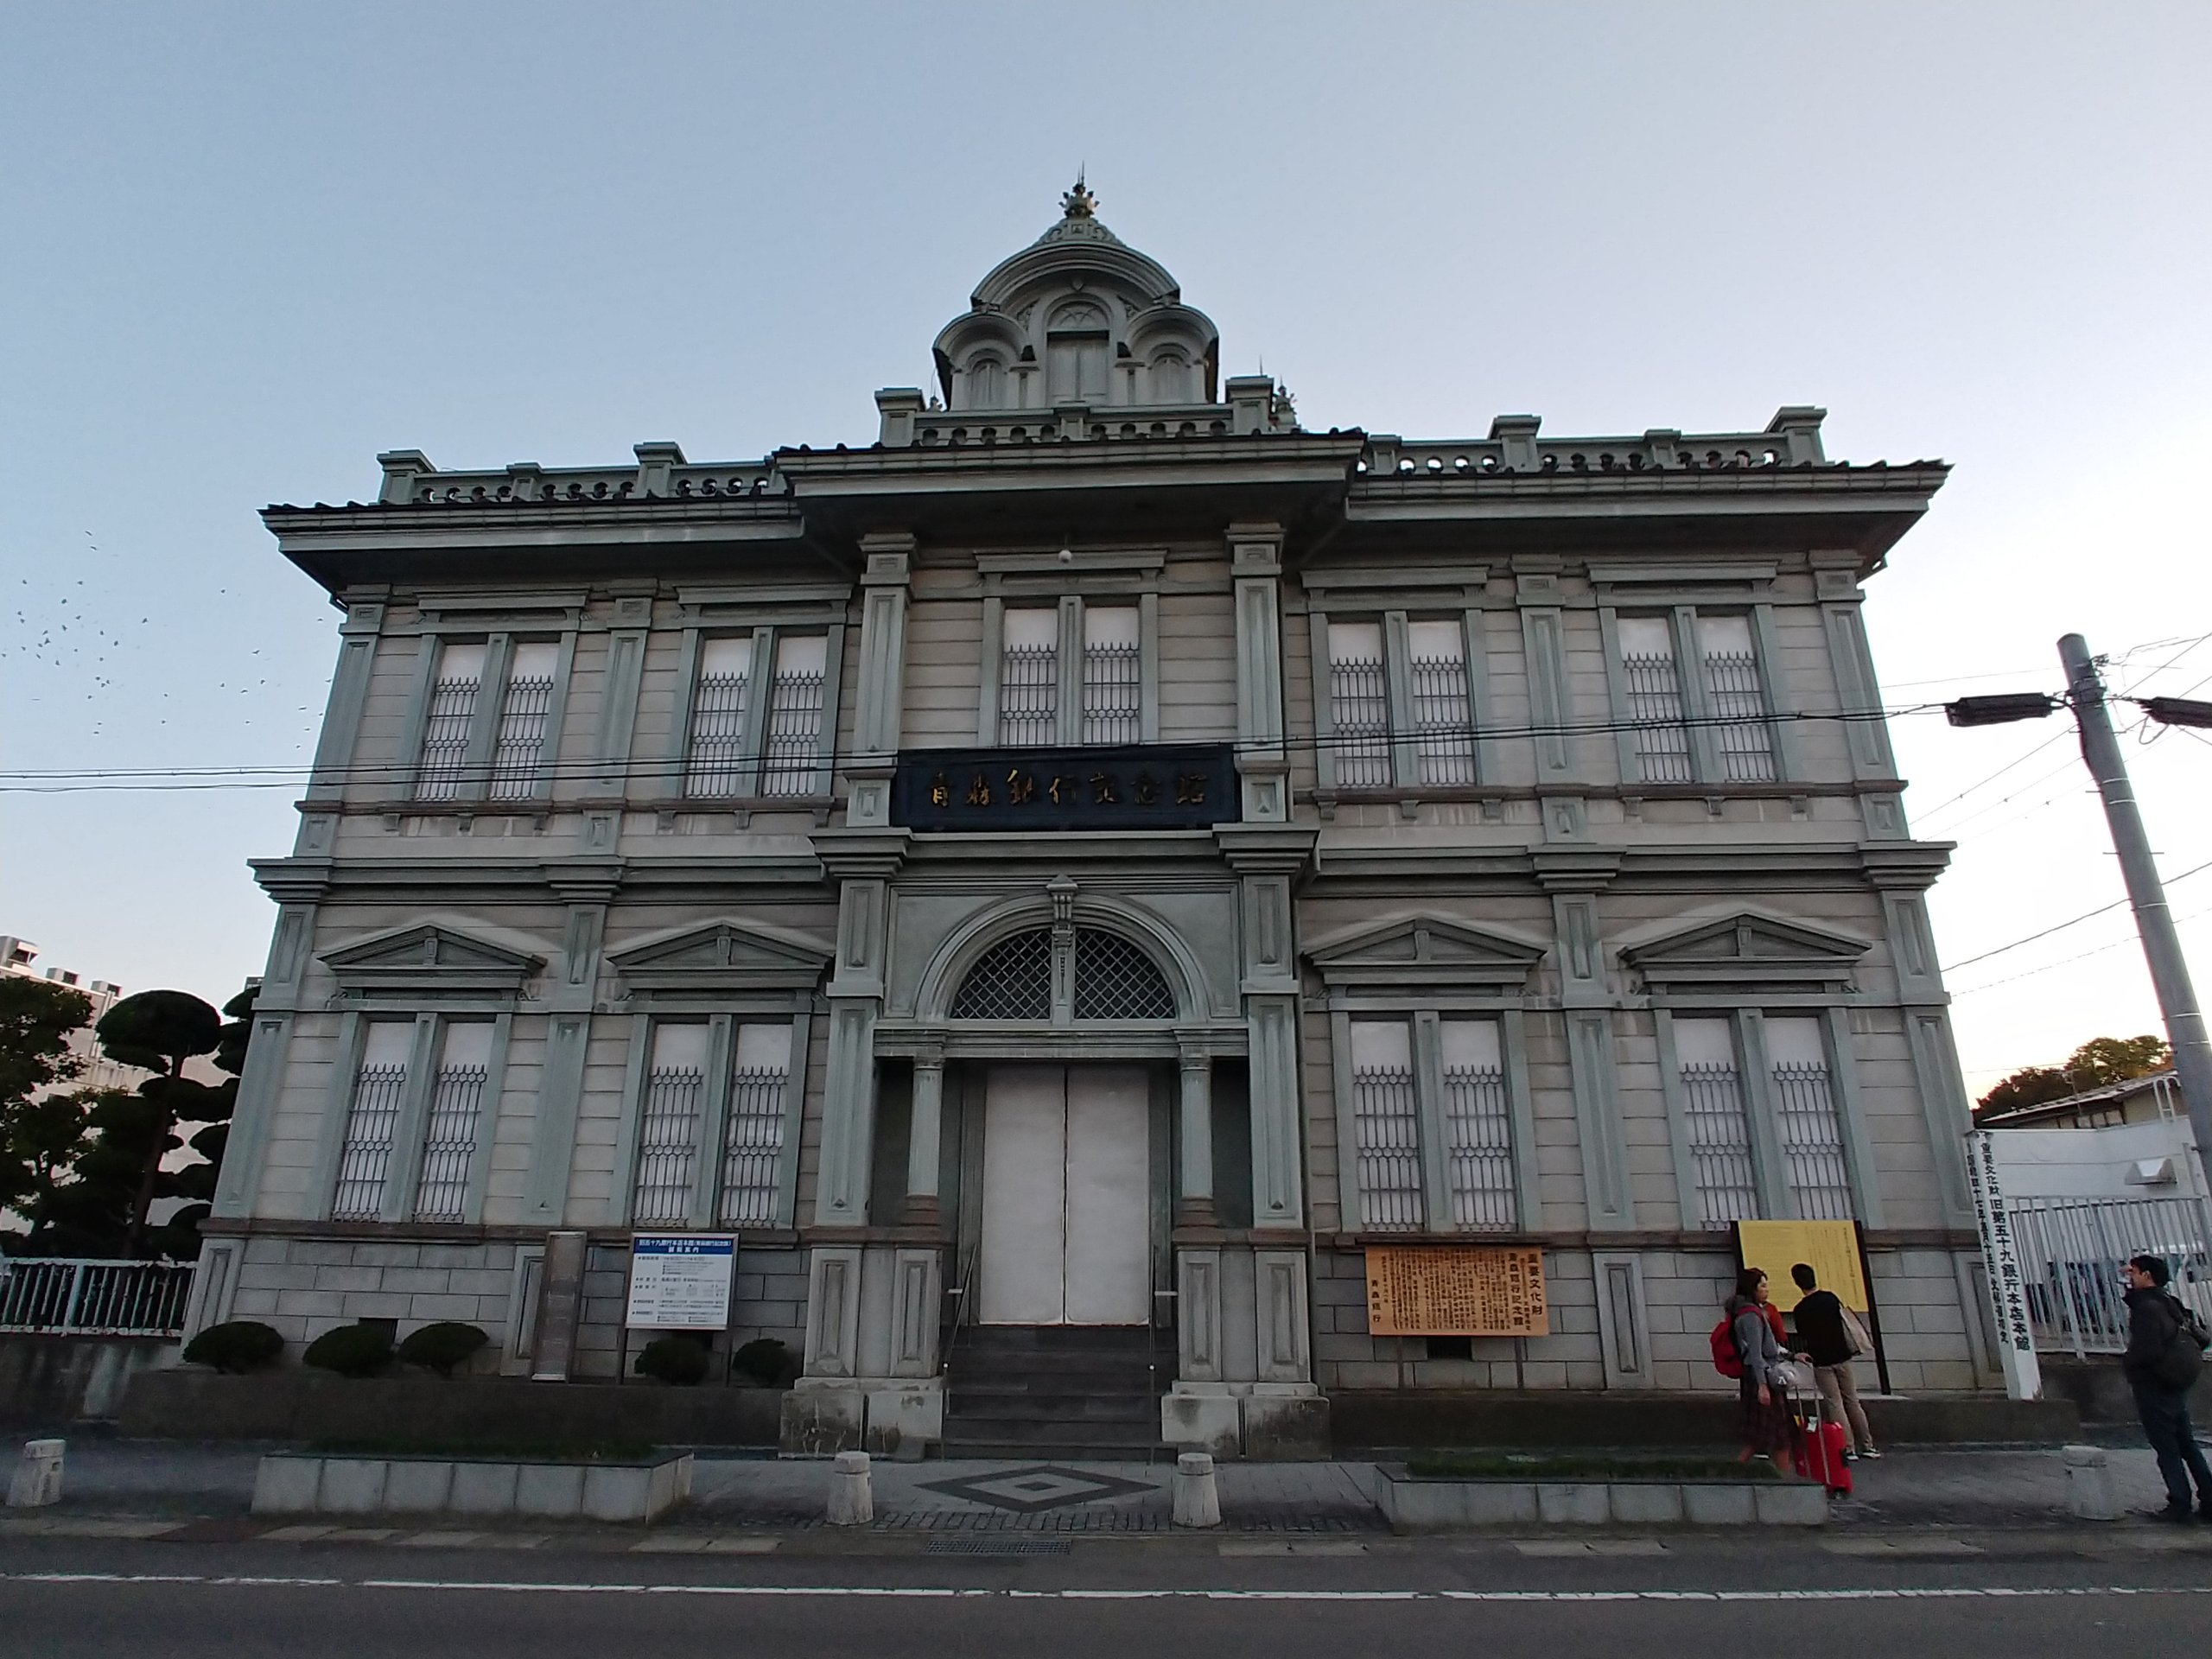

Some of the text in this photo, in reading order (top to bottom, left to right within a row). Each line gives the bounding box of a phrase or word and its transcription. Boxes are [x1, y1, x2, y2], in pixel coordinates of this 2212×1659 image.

[1528, 1253, 1542, 1315] 重要文化財
[1980, 1142, 2030, 1351] 重要文化財 旧第五十九銀行本店本館
